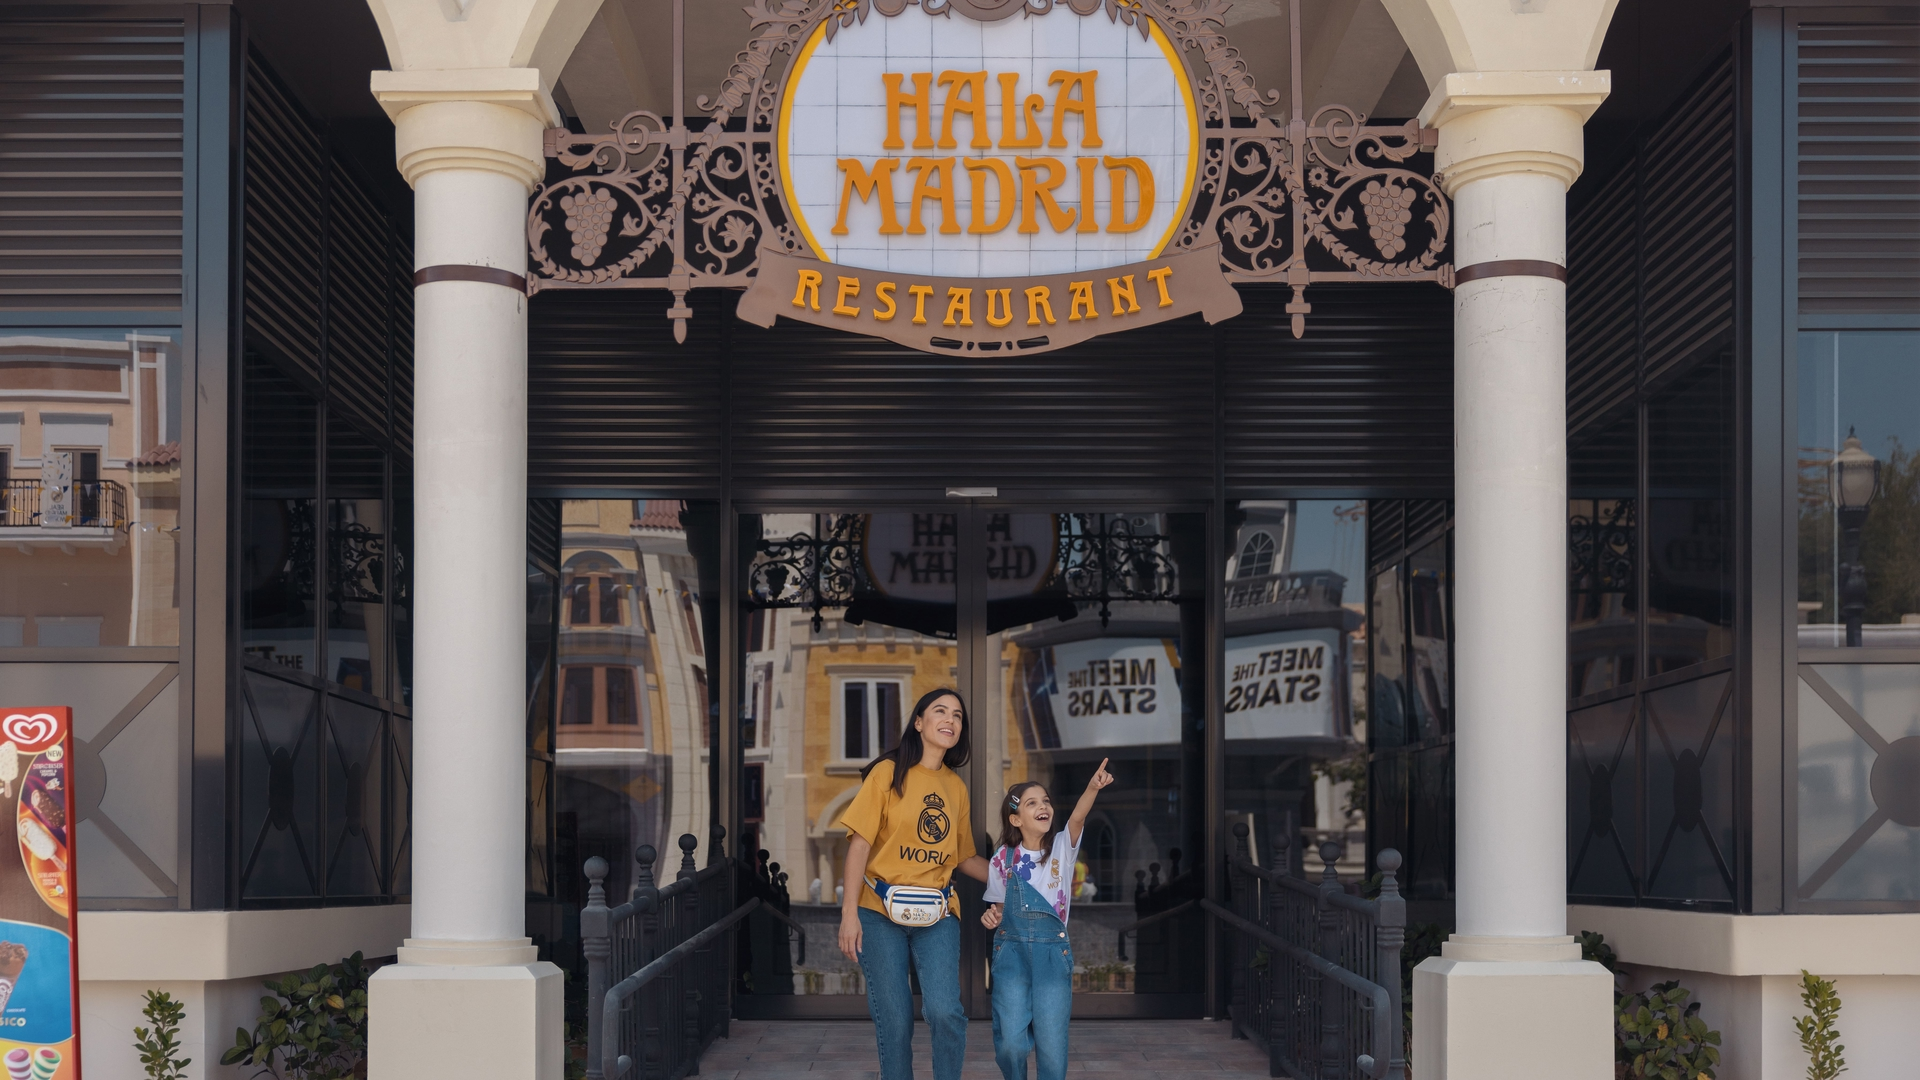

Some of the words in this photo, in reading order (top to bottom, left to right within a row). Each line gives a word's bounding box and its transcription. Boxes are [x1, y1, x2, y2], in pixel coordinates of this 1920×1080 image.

[882, 70, 1104, 149] HALA
[830, 155, 1156, 236] MADRID
[791, 266, 1175, 327] RESTAURANT
[912, 513, 1012, 546] HAA
[47, 750, 62, 758] NEW
